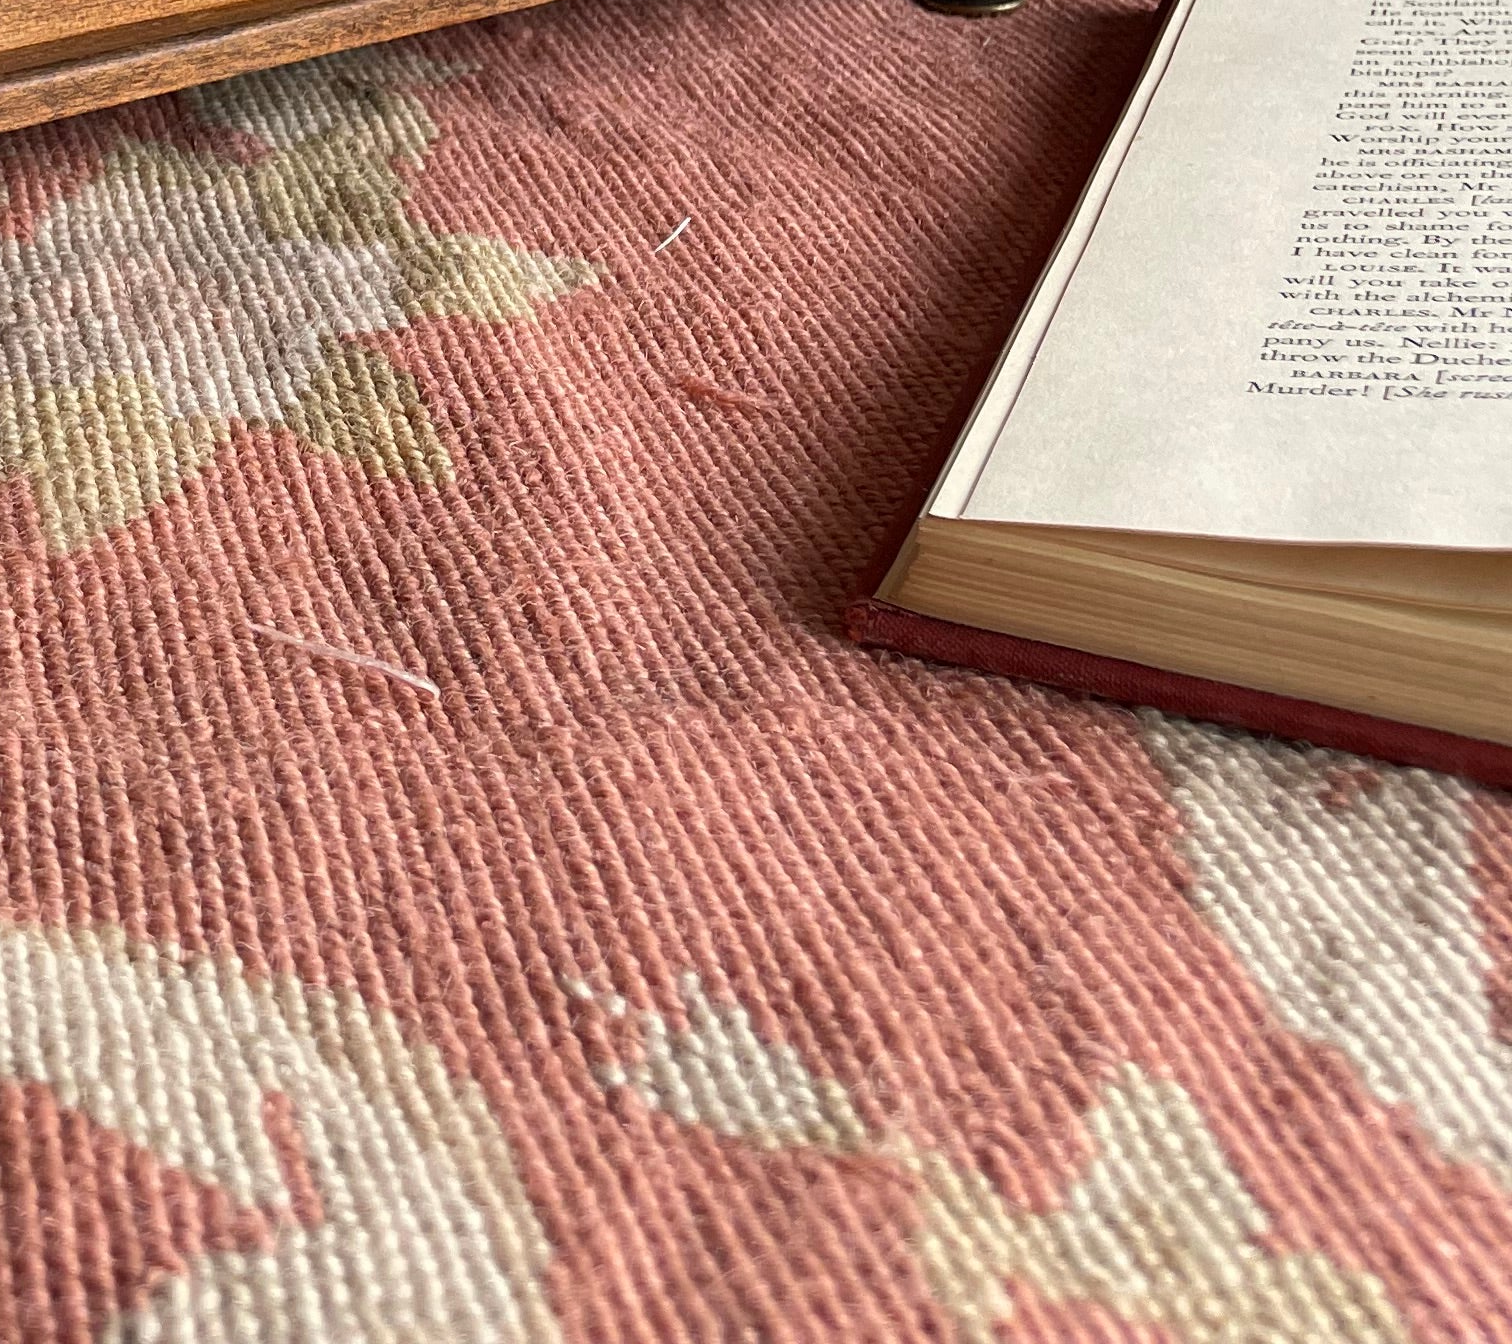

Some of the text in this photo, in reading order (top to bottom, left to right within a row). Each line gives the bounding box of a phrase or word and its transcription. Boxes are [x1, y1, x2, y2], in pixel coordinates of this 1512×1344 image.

[1364, 18, 1414, 26] calls
[1453, 28, 1497, 36] Are
[1359, 38, 1424, 46] God?
[1434, 37, 1498, 47] They
[1392, 57, 1512, 66] archbisho
[1350, 67, 1454, 79] bishops?
[1344, 89, 1387, 97] this
[1337, 102, 1391, 110] pare
[1401, 100, 1449, 108] him
[1335, 111, 1390, 120] God
[1401, 111, 1446, 120] will
[1436, 123, 1499, 131] How
[1329, 133, 1512, 145] Worship your
[1320, 157, 1350, 166] he
[1356, 158, 1377, 167] is
[1315, 169, 1394, 179] above
[1312, 182, 1499, 192] catechism, Mr
[1302, 207, 1425, 218] gravelled
[1436, 210, 1489, 220] you
[1385, 220, 1470, 230] shame
[1293, 233, 1410, 246] nothing.
[1422, 234, 1461, 247] By
[1290, 246, 1304, 256] I
[1314, 246, 1379, 257] have
[1389, 248, 1459, 258] clean
[1322, 263, 1426, 273] LOUISE.
[1437, 262, 1462, 273] It
[1282, 275, 1335, 285] will
[1347, 278, 1403, 289] you
[1418, 277, 1478, 288] take
[1278, 289, 1340, 300] with
[1353, 290, 1397, 301] the
[1308, 307, 1441, 317] CHARLES.
[1448, 306, 1493, 317] Mr
[1267, 319, 1409, 332] tête-à-tête
[1412, 321, 1479, 333] with
[1261, 336, 1498, 349] pany us. Nellie:
[1260, 349, 1512, 365] throw the Duche
[1289, 369, 1422, 381] BARBARA
[1245, 381, 1370, 396] Murder!
[1382, 384, 1449, 400] [She
